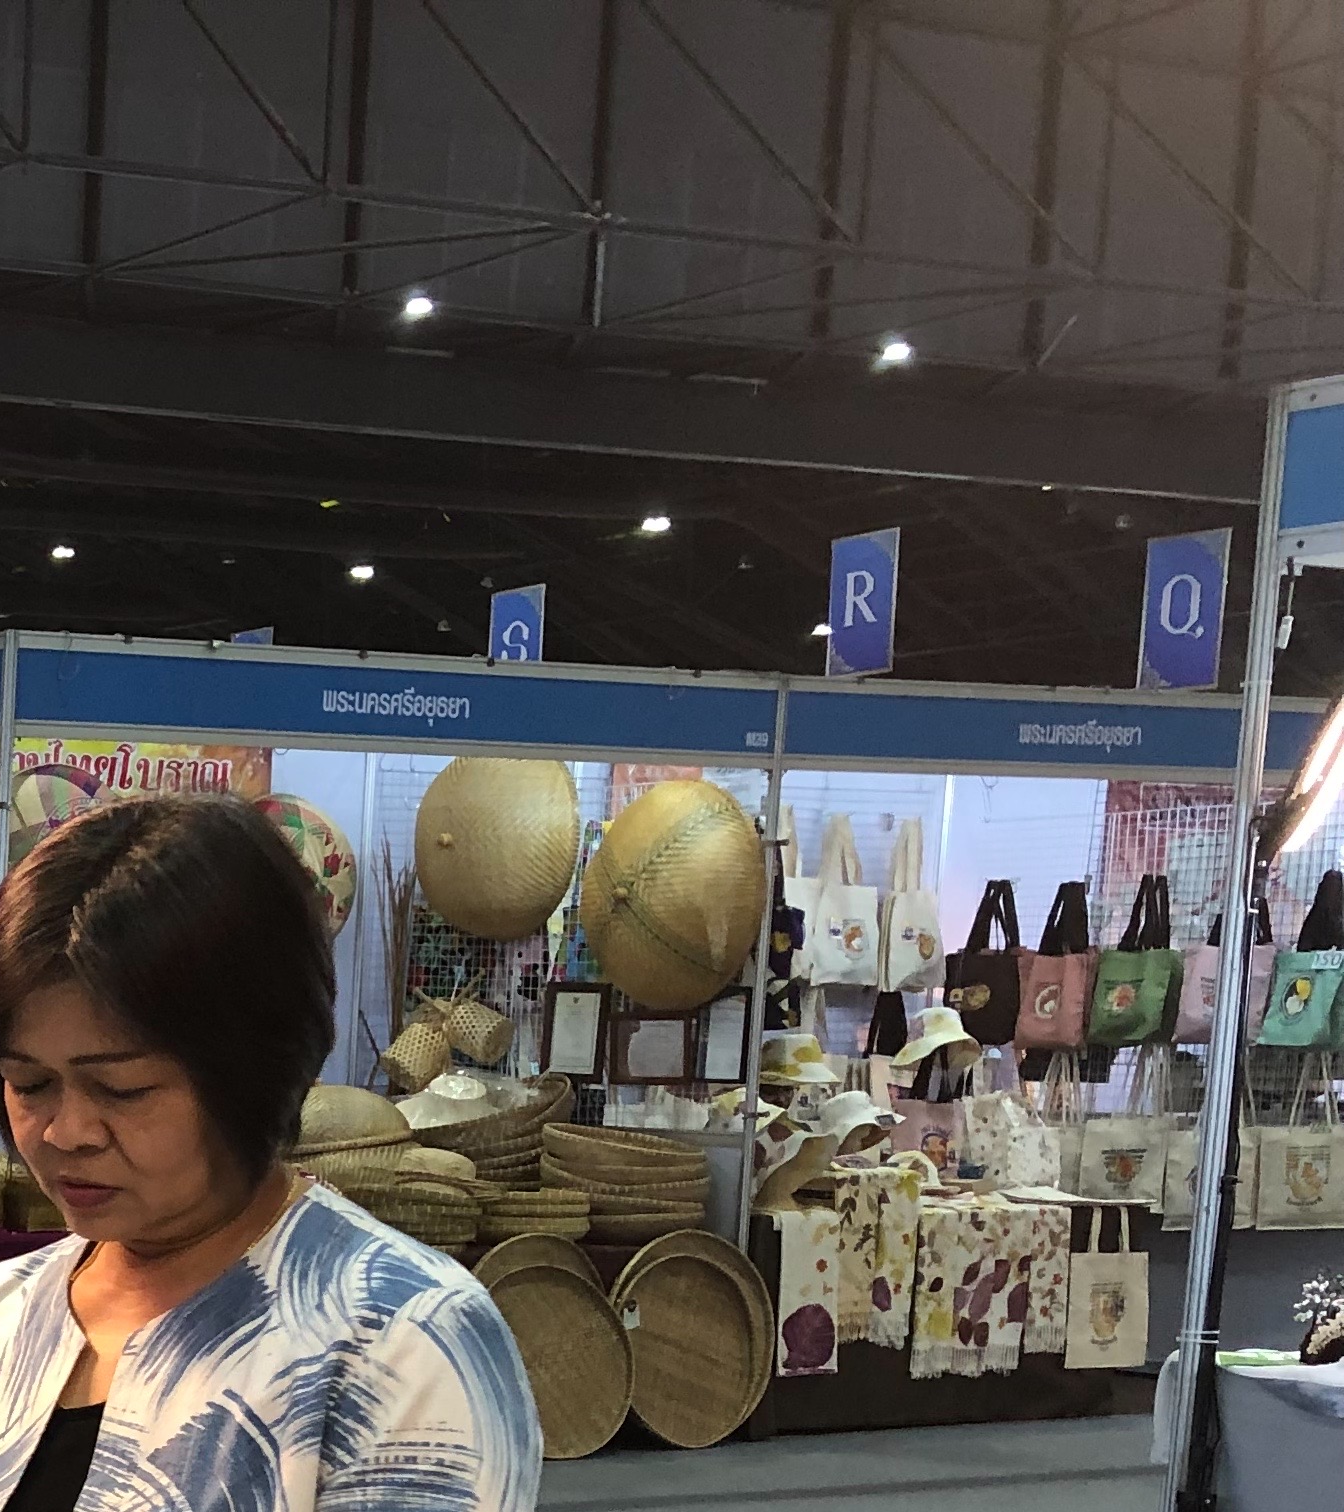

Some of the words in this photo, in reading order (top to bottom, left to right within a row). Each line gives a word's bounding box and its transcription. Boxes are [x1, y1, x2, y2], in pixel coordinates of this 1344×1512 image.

[843, 570, 878, 628] R
[1160, 573, 1205, 639] Q
[501, 620, 530, 662] S
[322, 687, 470, 727] พระนครศรีอยุธยา
[1018, 719, 1143, 753] พระนครศรีอยุธยา
